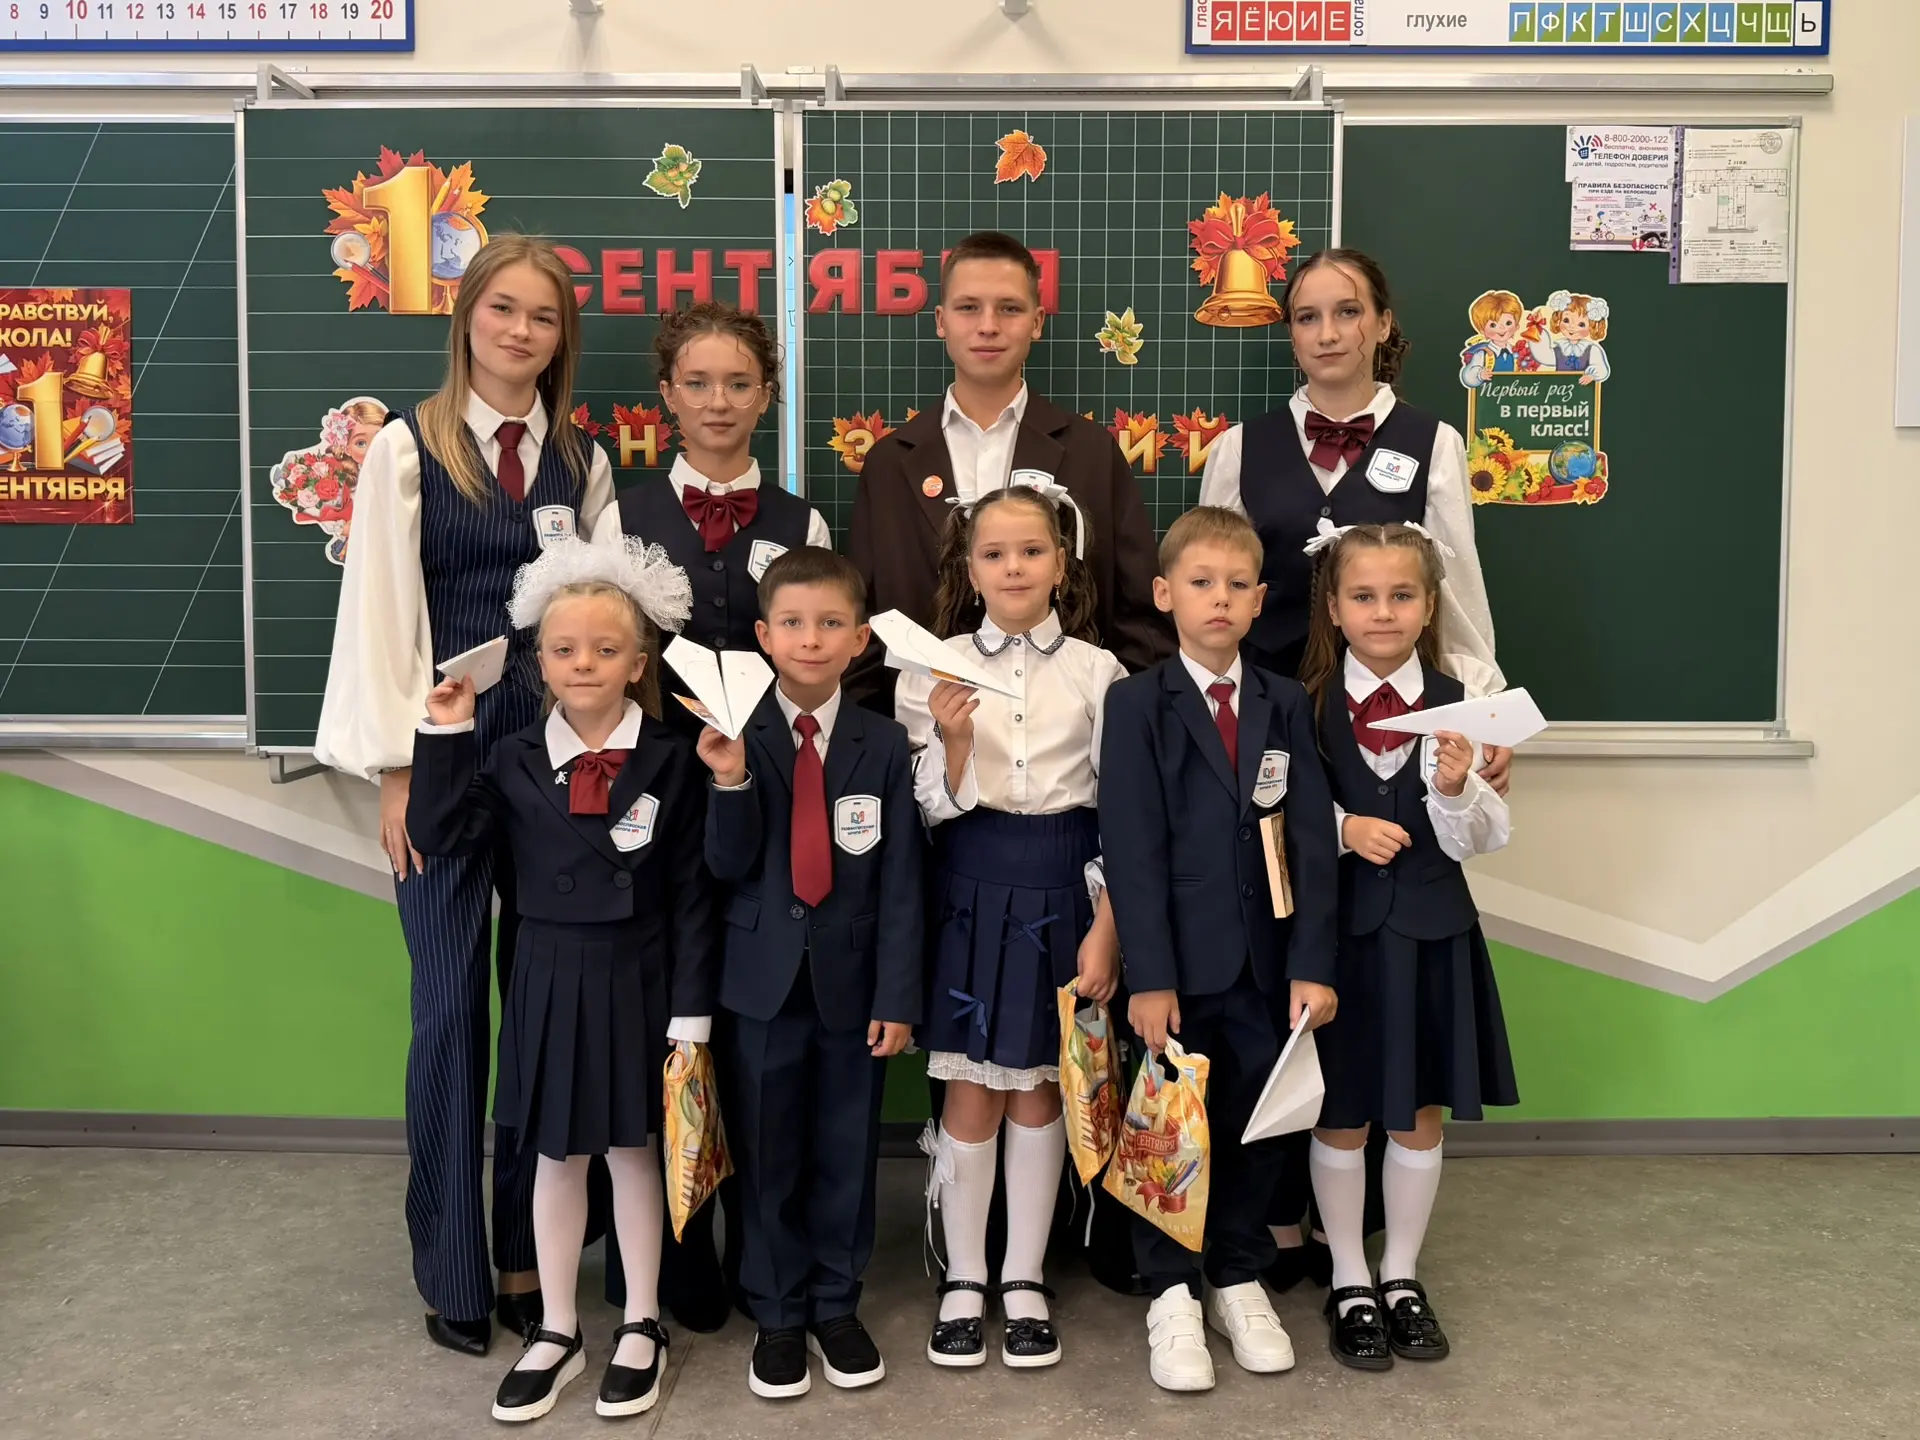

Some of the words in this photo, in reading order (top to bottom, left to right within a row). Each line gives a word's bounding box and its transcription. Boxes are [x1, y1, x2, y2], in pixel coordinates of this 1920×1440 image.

[10, 3, 19, 19] 8
[39, 3, 49, 19] 9
[66, 0, 88, 19] 10
[97, 3, 113, 19] 11
[126, 3, 144, 19] 12
[157, 3, 175, 19] 13
[187, 3, 206, 19] 14
[218, 3, 237, 19] 15
[249, 3, 267, 19] 16
[279, 3, 298, 19] 17
[310, 3, 328, 19] 18
[341, 3, 359, 19] 19
[371, 0, 394, 19] 20
[1406, 14, 1468, 31] глухие
[1513, 11, 1530, 32] П
[1541, 12, 1560, 32] Ф
[1572, 12, 1588, 32] К
[1600, 12, 1616, 32] Т
[1625, 12, 1647, 32] Ш
[1655, 12, 1673, 32] С
[1683, 12, 1703, 32] Х
[1712, 13, 1731, 37] Ц
[1741, 13, 1757, 32] Ч
[1767, 13, 1791, 38] Щ
[1801, 13, 1817, 32] Ь
[1604, 134, 1669, 144] 8-800-2000-122
[0, 327, 72, 348] КОЛА!
[1479, 379, 1541, 404] Первый
[1544, 383, 1575, 403] раз
[1500, 405, 1511, 418] в
[1517, 401, 1589, 422] первый
[1530, 419, 1590, 437] класс!
